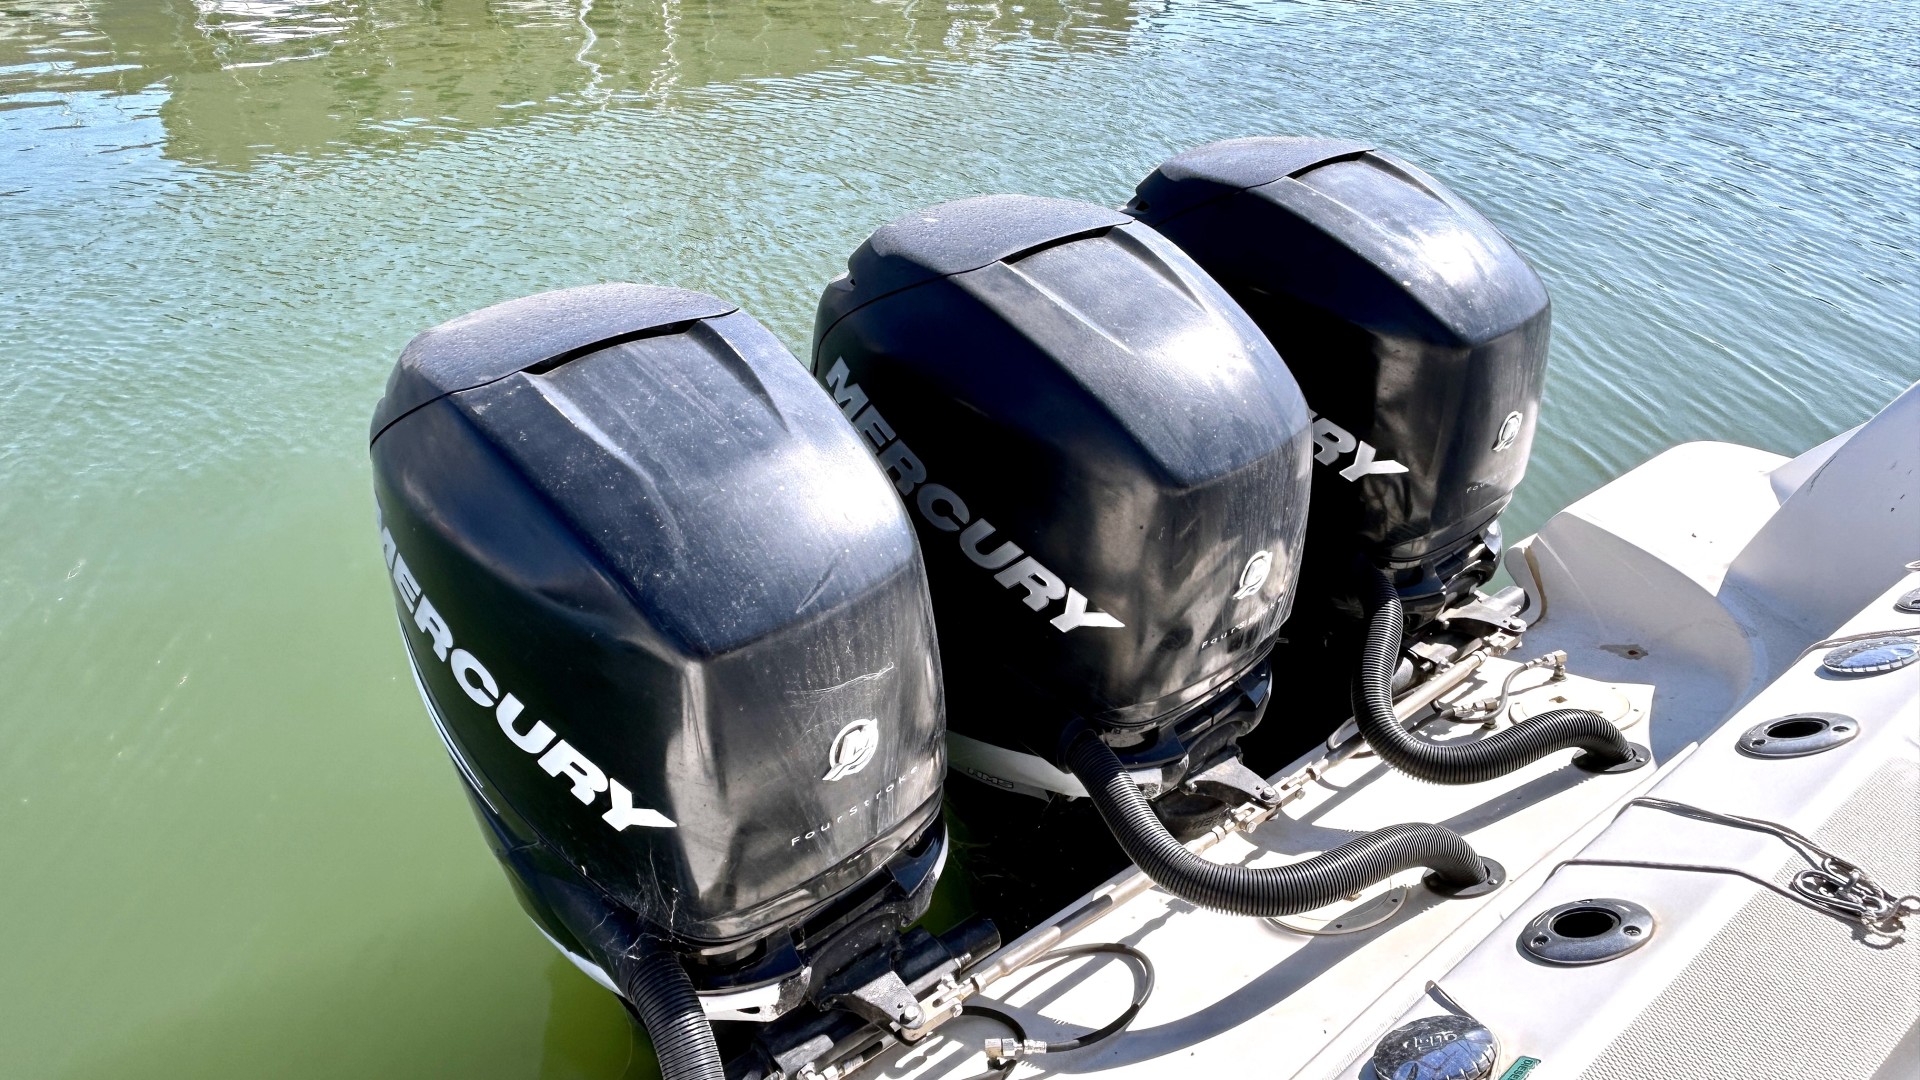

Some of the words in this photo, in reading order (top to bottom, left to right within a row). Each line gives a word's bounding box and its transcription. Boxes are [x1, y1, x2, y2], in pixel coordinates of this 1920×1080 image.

[1311, 410, 1410, 482] RY
[826, 357, 1125, 633] MERCURY
[1201, 595, 1284, 649] FourSke
[376, 503, 677, 832] MERCURY
[791, 766, 918, 847] FourStroke
